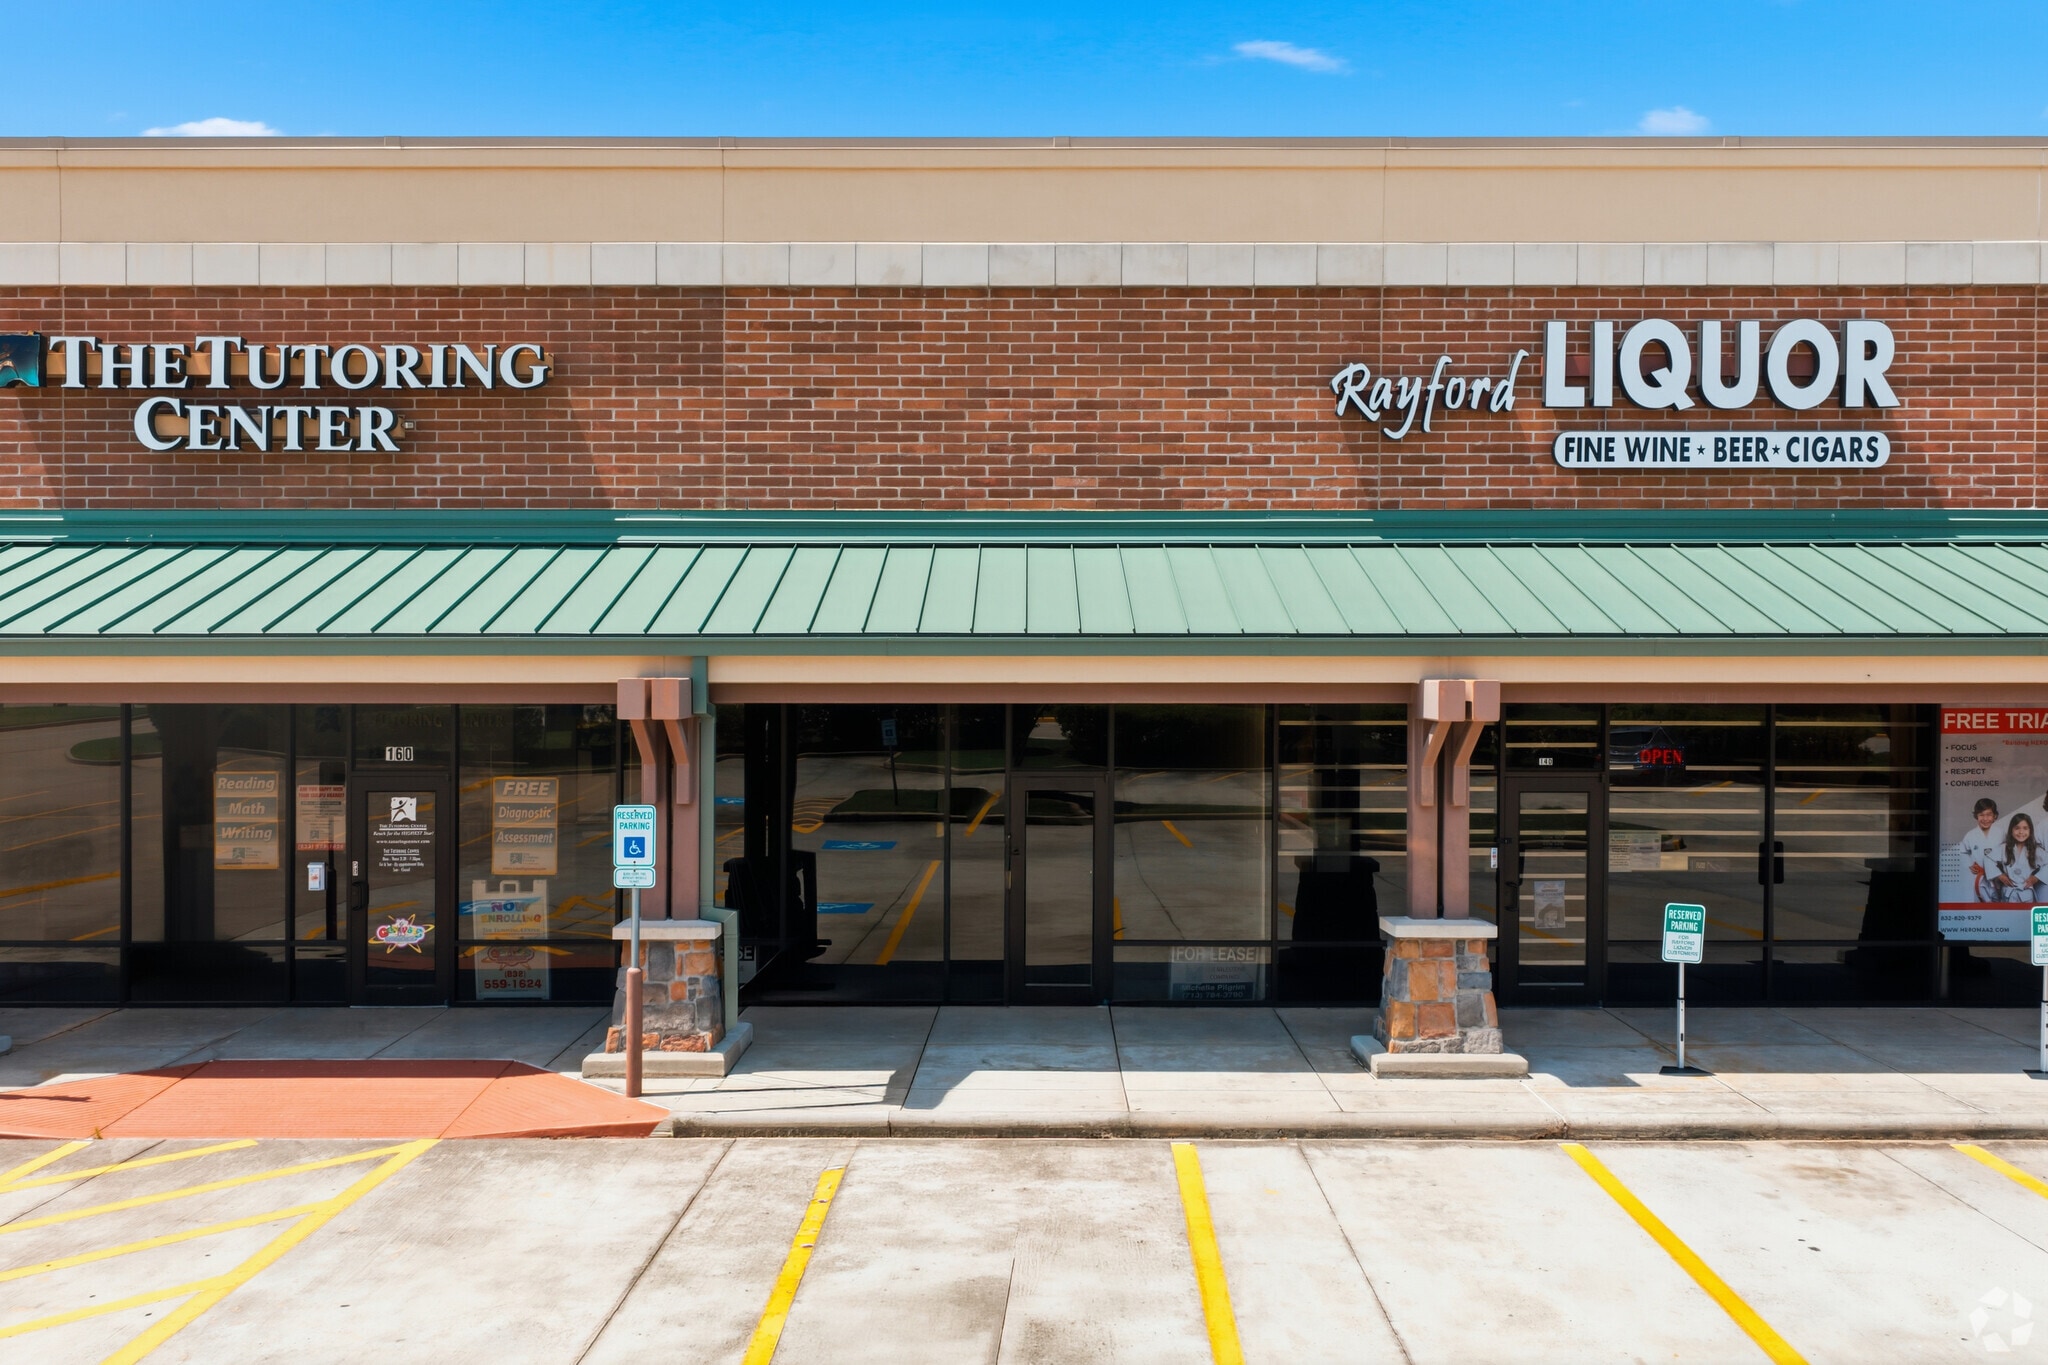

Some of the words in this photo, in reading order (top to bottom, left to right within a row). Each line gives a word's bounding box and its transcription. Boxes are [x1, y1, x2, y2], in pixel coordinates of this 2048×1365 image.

[49, 335, 191, 389] THE
[195, 335, 550, 390] TUTORING
[1544, 318, 1901, 411] LIQUOR
[1331, 349, 1530, 440] Rayford
[133, 396, 401, 452] CENTER
[1564, 436, 1616, 463] FINE
[1624, 436, 1691, 463] WINE
[1712, 436, 1769, 463] BEER
[1785, 436, 1880, 463] CIGARS
[1943, 712, 2000, 729] FREE
[385, 746, 414, 762] 160
[1639, 748, 1683, 765] OPEN
[217, 776, 276, 792] Reading
[502, 781, 552, 796] FREE
[228, 801, 266, 815] Math
[498, 806, 553, 821] Diagnostic
[616, 811, 653, 820] RESERVED
[221, 826, 274, 842] Writing
[619, 822, 651, 831] PARKING
[496, 831, 554, 844] Assessment
[491, 901, 530, 913] NOW
[480, 913, 542, 923] ENROLLING
[1669, 910, 1701, 920] RESERVED
[1671, 921, 1698, 931] PARKING
[1176, 946, 1205, 961] FOR
[1209, 946, 1255, 961] LEASE
[483, 979, 542, 989] 559-1624
